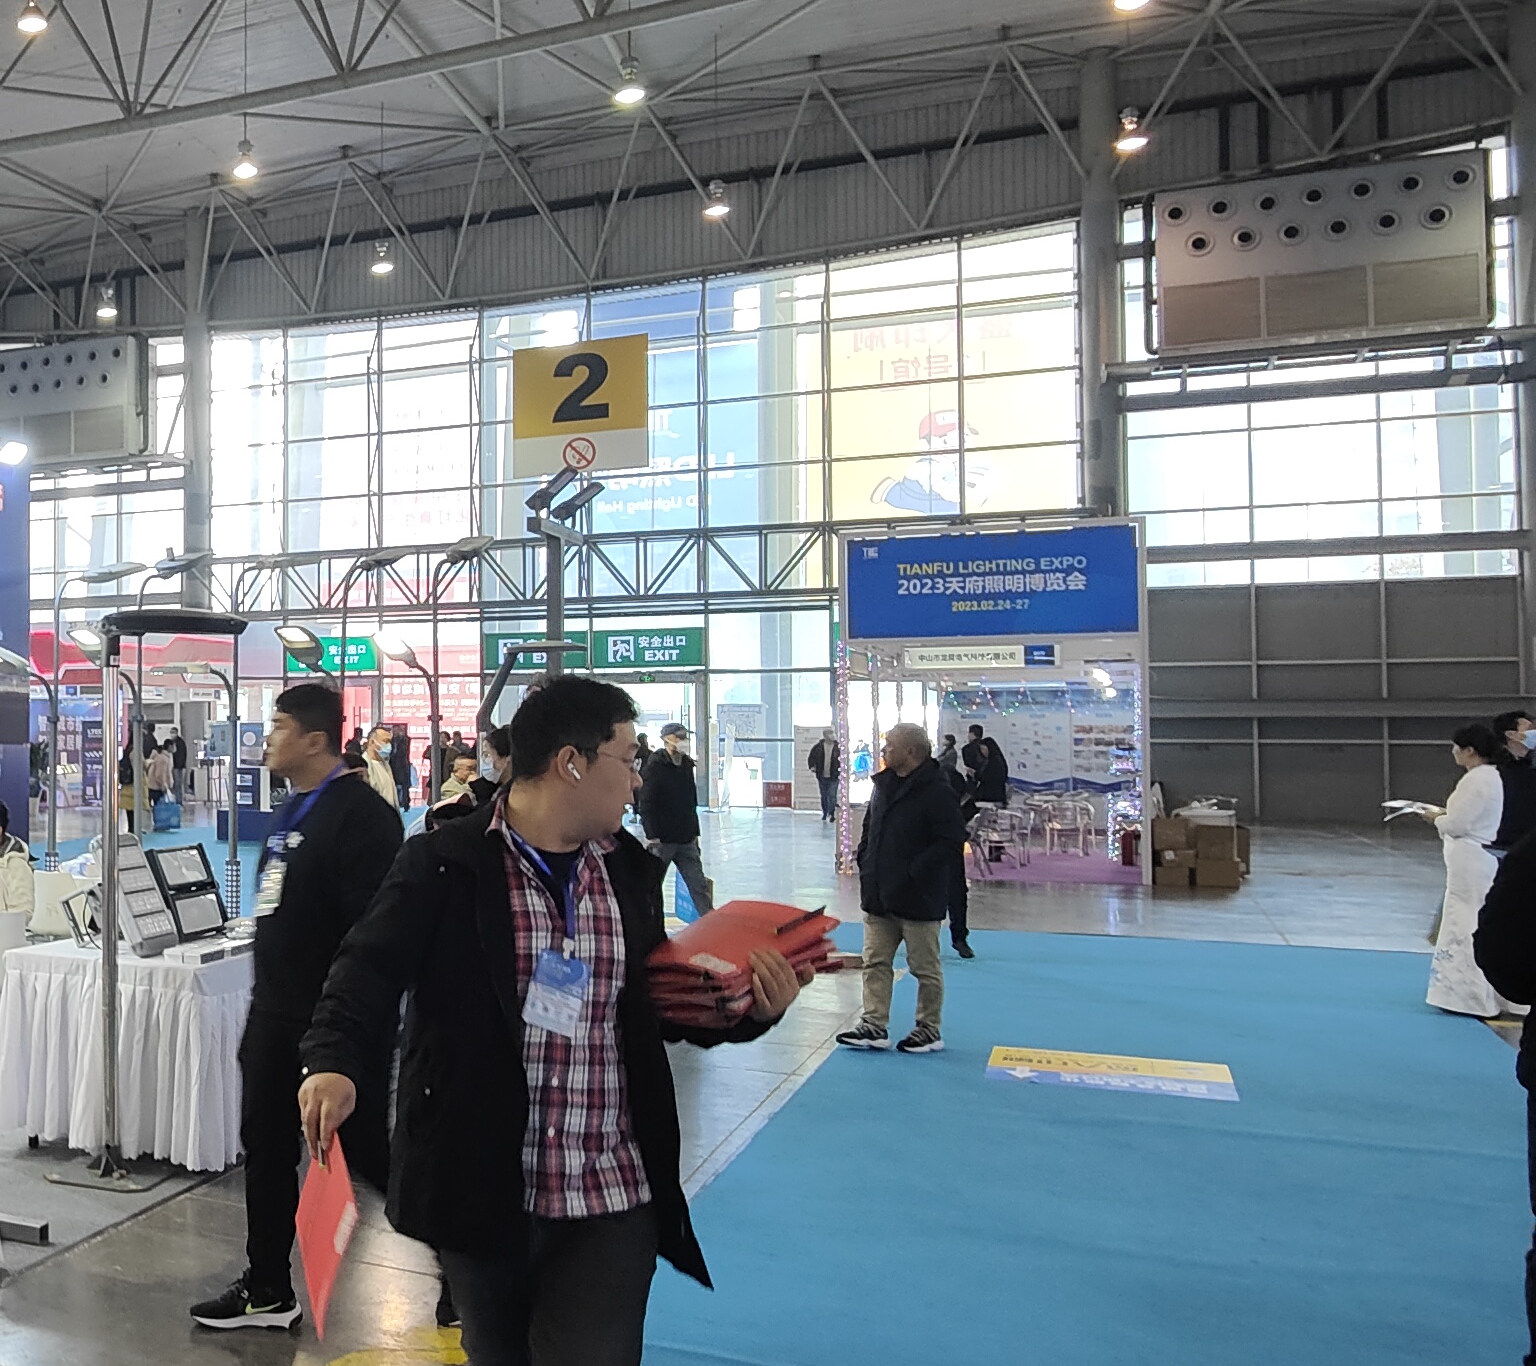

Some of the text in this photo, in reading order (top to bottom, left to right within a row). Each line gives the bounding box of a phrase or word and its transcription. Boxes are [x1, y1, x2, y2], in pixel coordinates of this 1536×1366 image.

[552, 352, 610, 424] 2
[897, 555, 1087, 576] TIANFU LIGHTING EXPO
[897, 571, 1088, 596] 2023天府照明博览会
[951, 598, 1030, 613] 2023.02.24-27
[638, 634, 687, 648] 安全出口
[644, 649, 680, 662] EXIT
